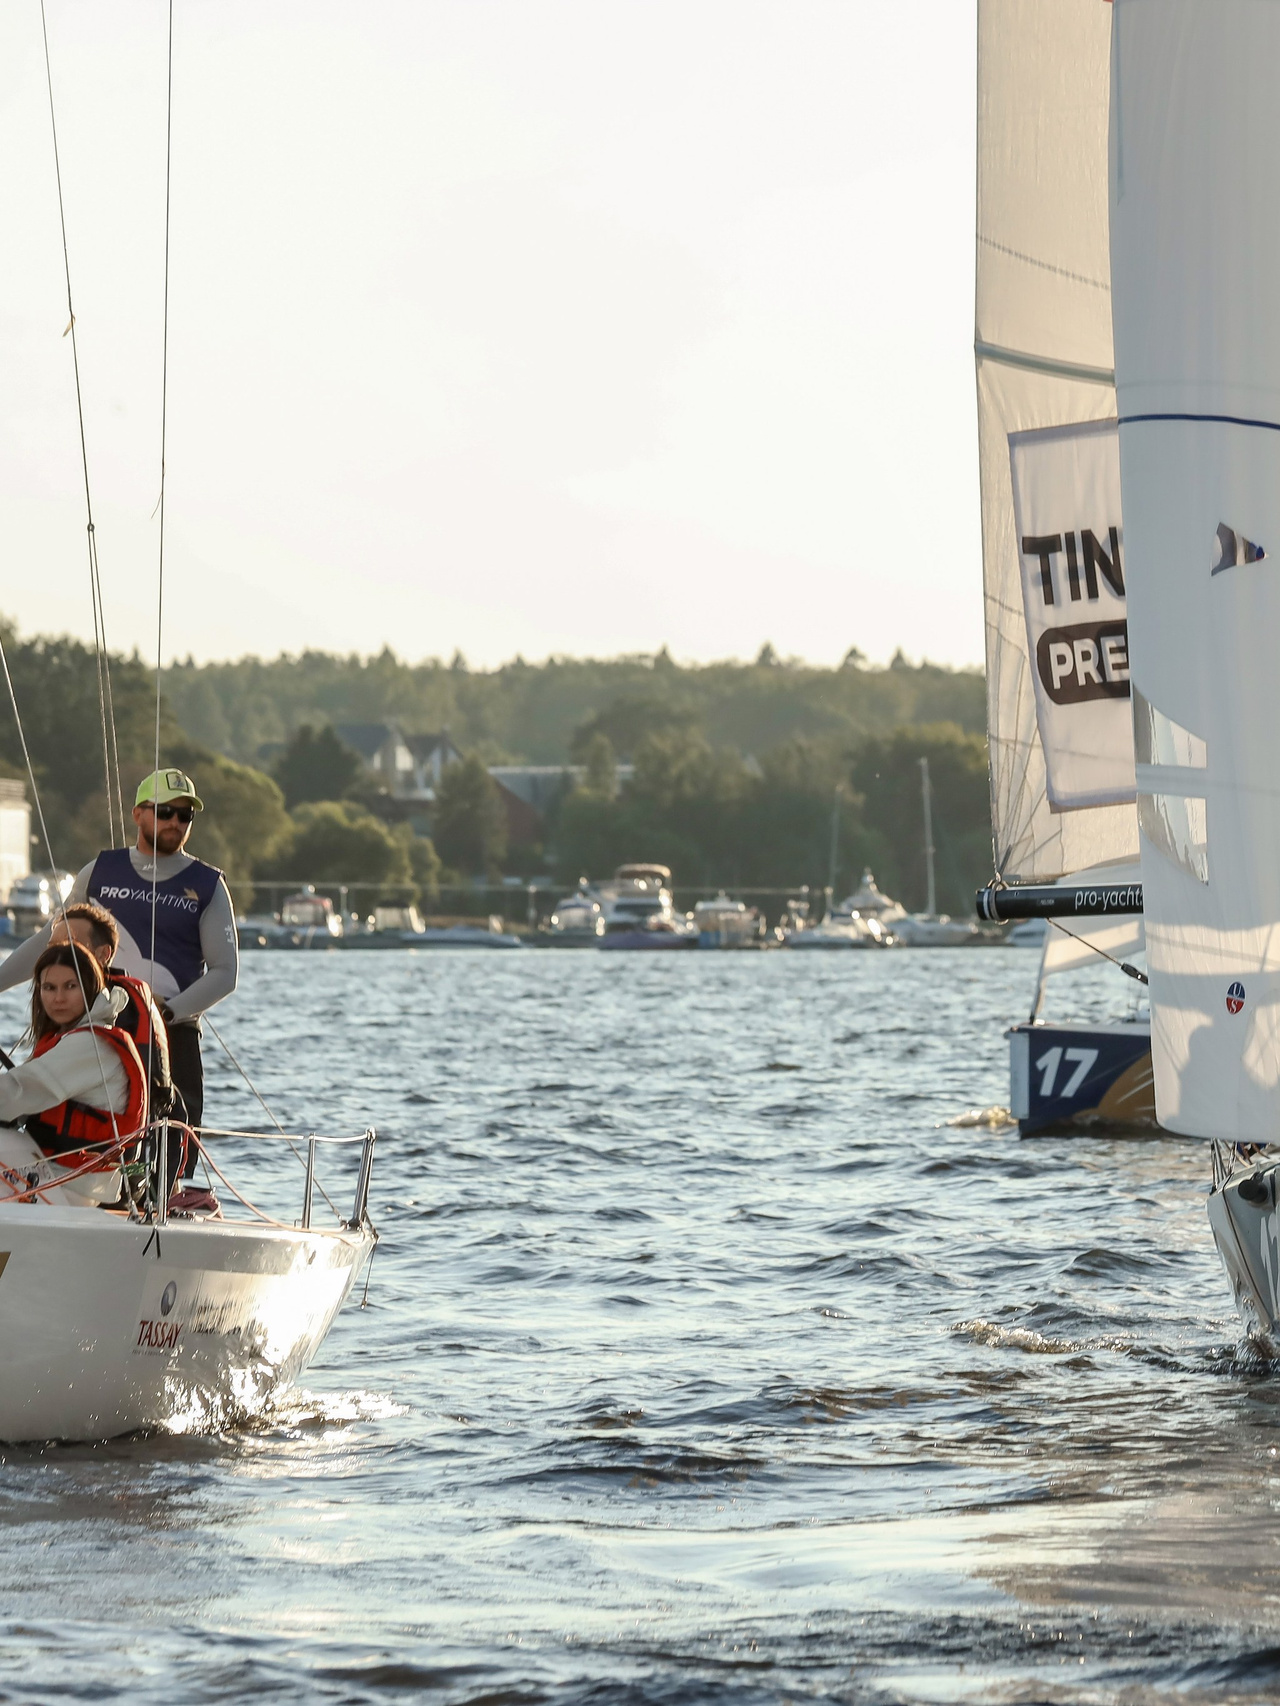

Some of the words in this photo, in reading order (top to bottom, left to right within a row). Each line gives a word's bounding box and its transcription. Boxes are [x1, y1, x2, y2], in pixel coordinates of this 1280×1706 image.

[99, 885, 199, 913] PROYACHTING
[1035, 1046, 1099, 1098] 17
[137, 1319, 184, 1349] TASSAY
